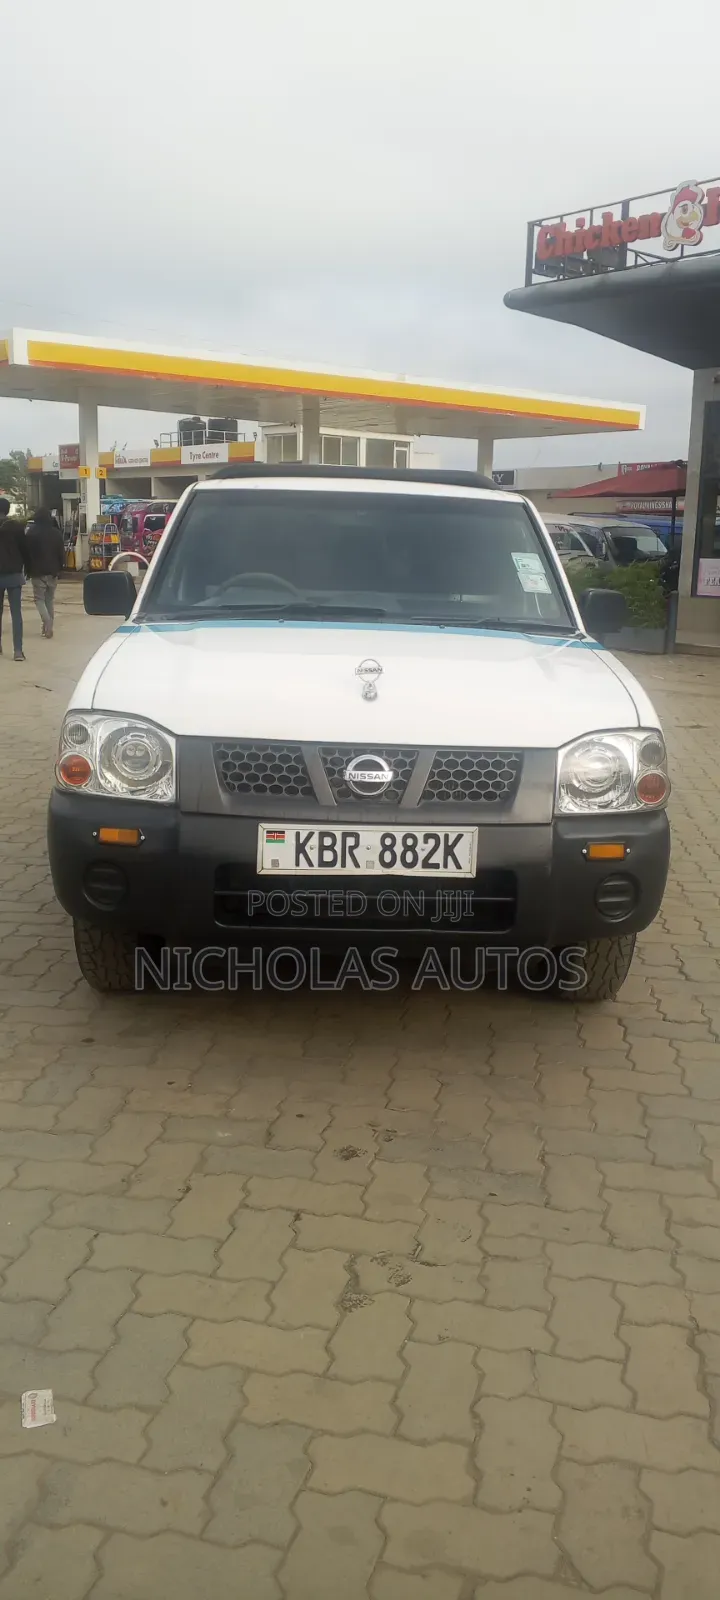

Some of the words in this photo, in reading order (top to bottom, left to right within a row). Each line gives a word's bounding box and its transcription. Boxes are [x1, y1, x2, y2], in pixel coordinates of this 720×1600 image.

[536, 211, 662, 261] Chicken
[189, 451, 202, 462] Tyre
[202, 450, 219, 460] Centre
[348, 772, 389, 780] NISSAN
[295, 831, 361, 869] KBR
[378, 832, 464, 870] 882K
